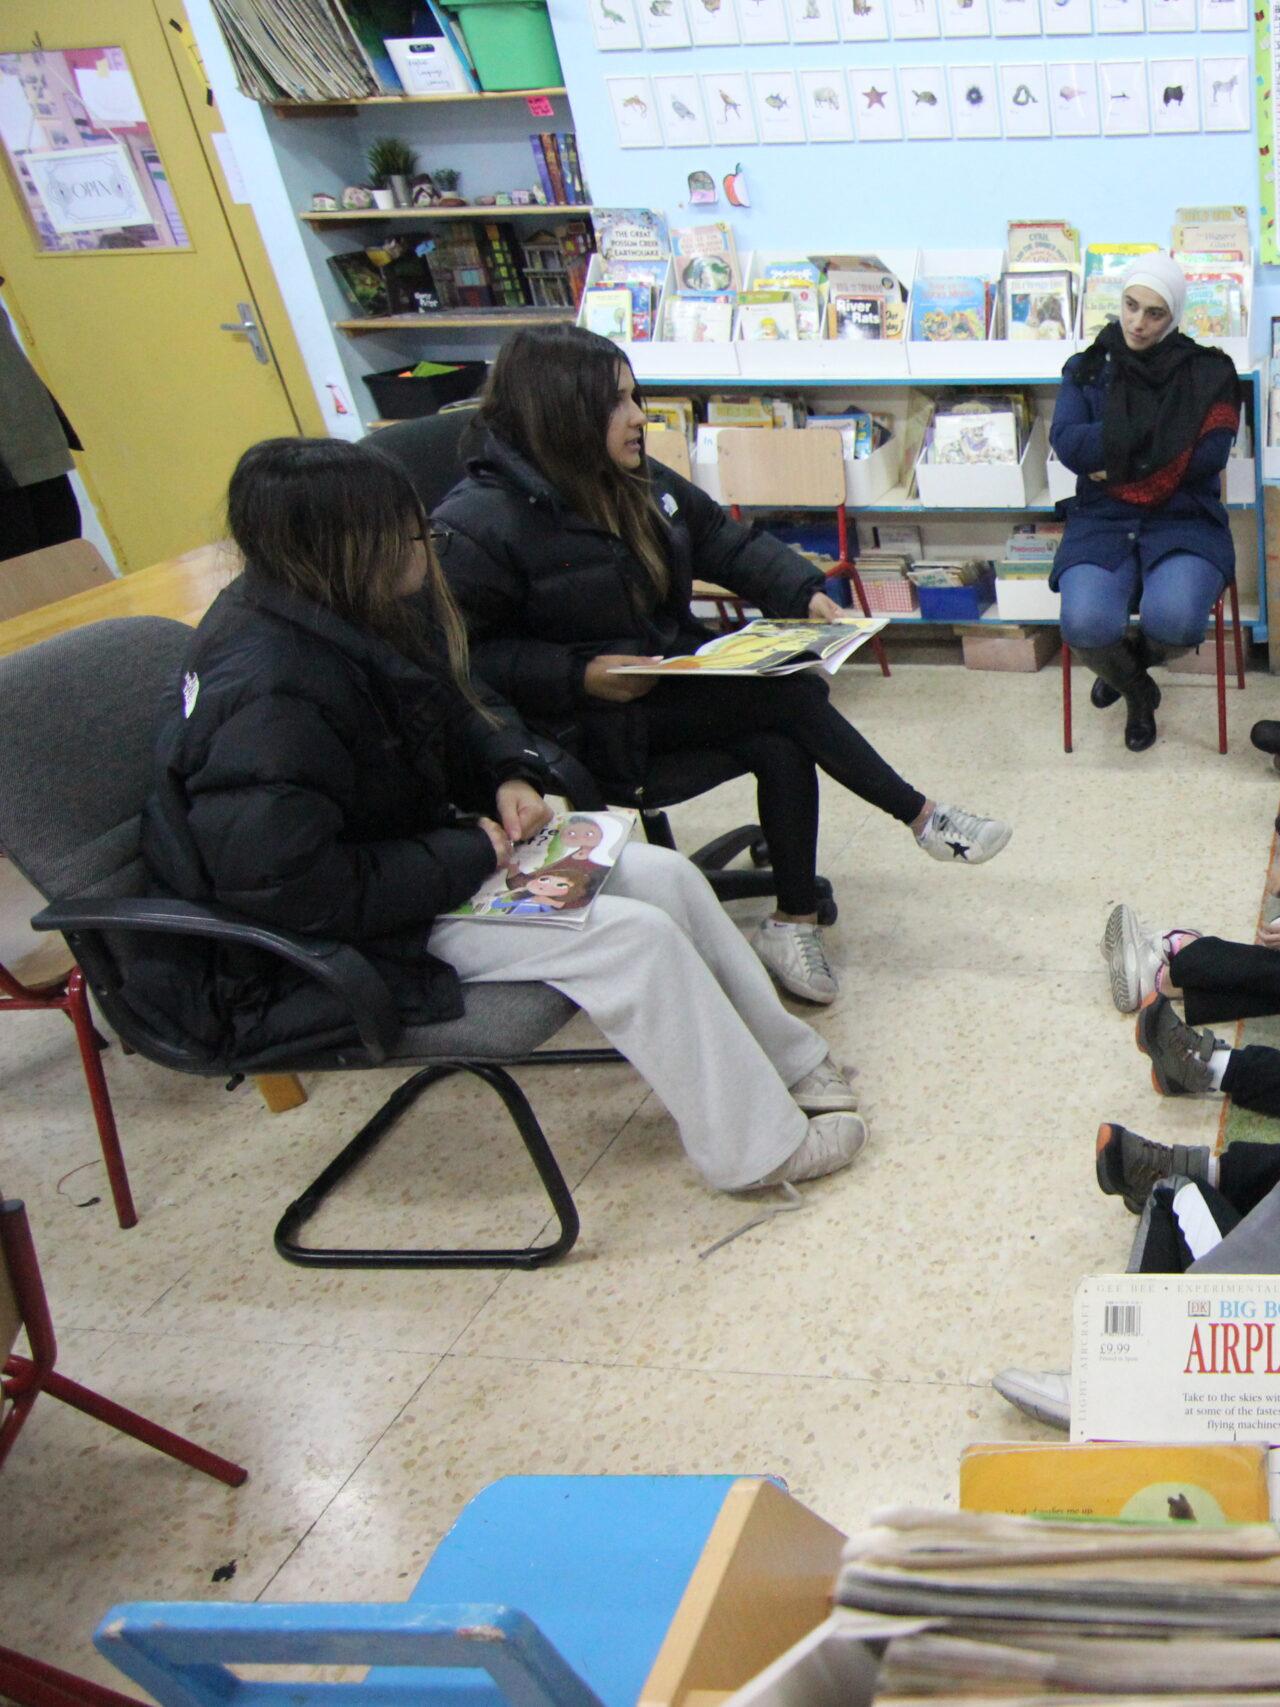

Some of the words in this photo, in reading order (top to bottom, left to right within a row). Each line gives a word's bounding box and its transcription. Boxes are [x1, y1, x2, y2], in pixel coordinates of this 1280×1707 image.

[836, 300, 872, 313] River
[851, 313, 880, 325] Rats
[1096, 1284, 1121, 1293] GEE
[1132, 1284, 1155, 1293] BEE
[1177, 1284, 1279, 1293] EXPERIMENTAL
[1190, 1302, 1209, 1315] DK
[1219, 1300, 1256, 1318] BIG
[1080, 1304, 1089, 1369] AIRCRAFT
[1100, 1343, 1130, 1355] £9.99
[1183, 1393, 1204, 1402] Take
[1208, 1394, 1217, 1402] to
[1220, 1393, 1236, 1402] the
[1239, 1393, 1262, 1402] skies
[1185, 1407, 1193, 1415] at
[1224, 1406, 1235, 1415] of
[1238, 1406, 1252, 1415] the
[1207, 1419, 1235, 1431] flying
